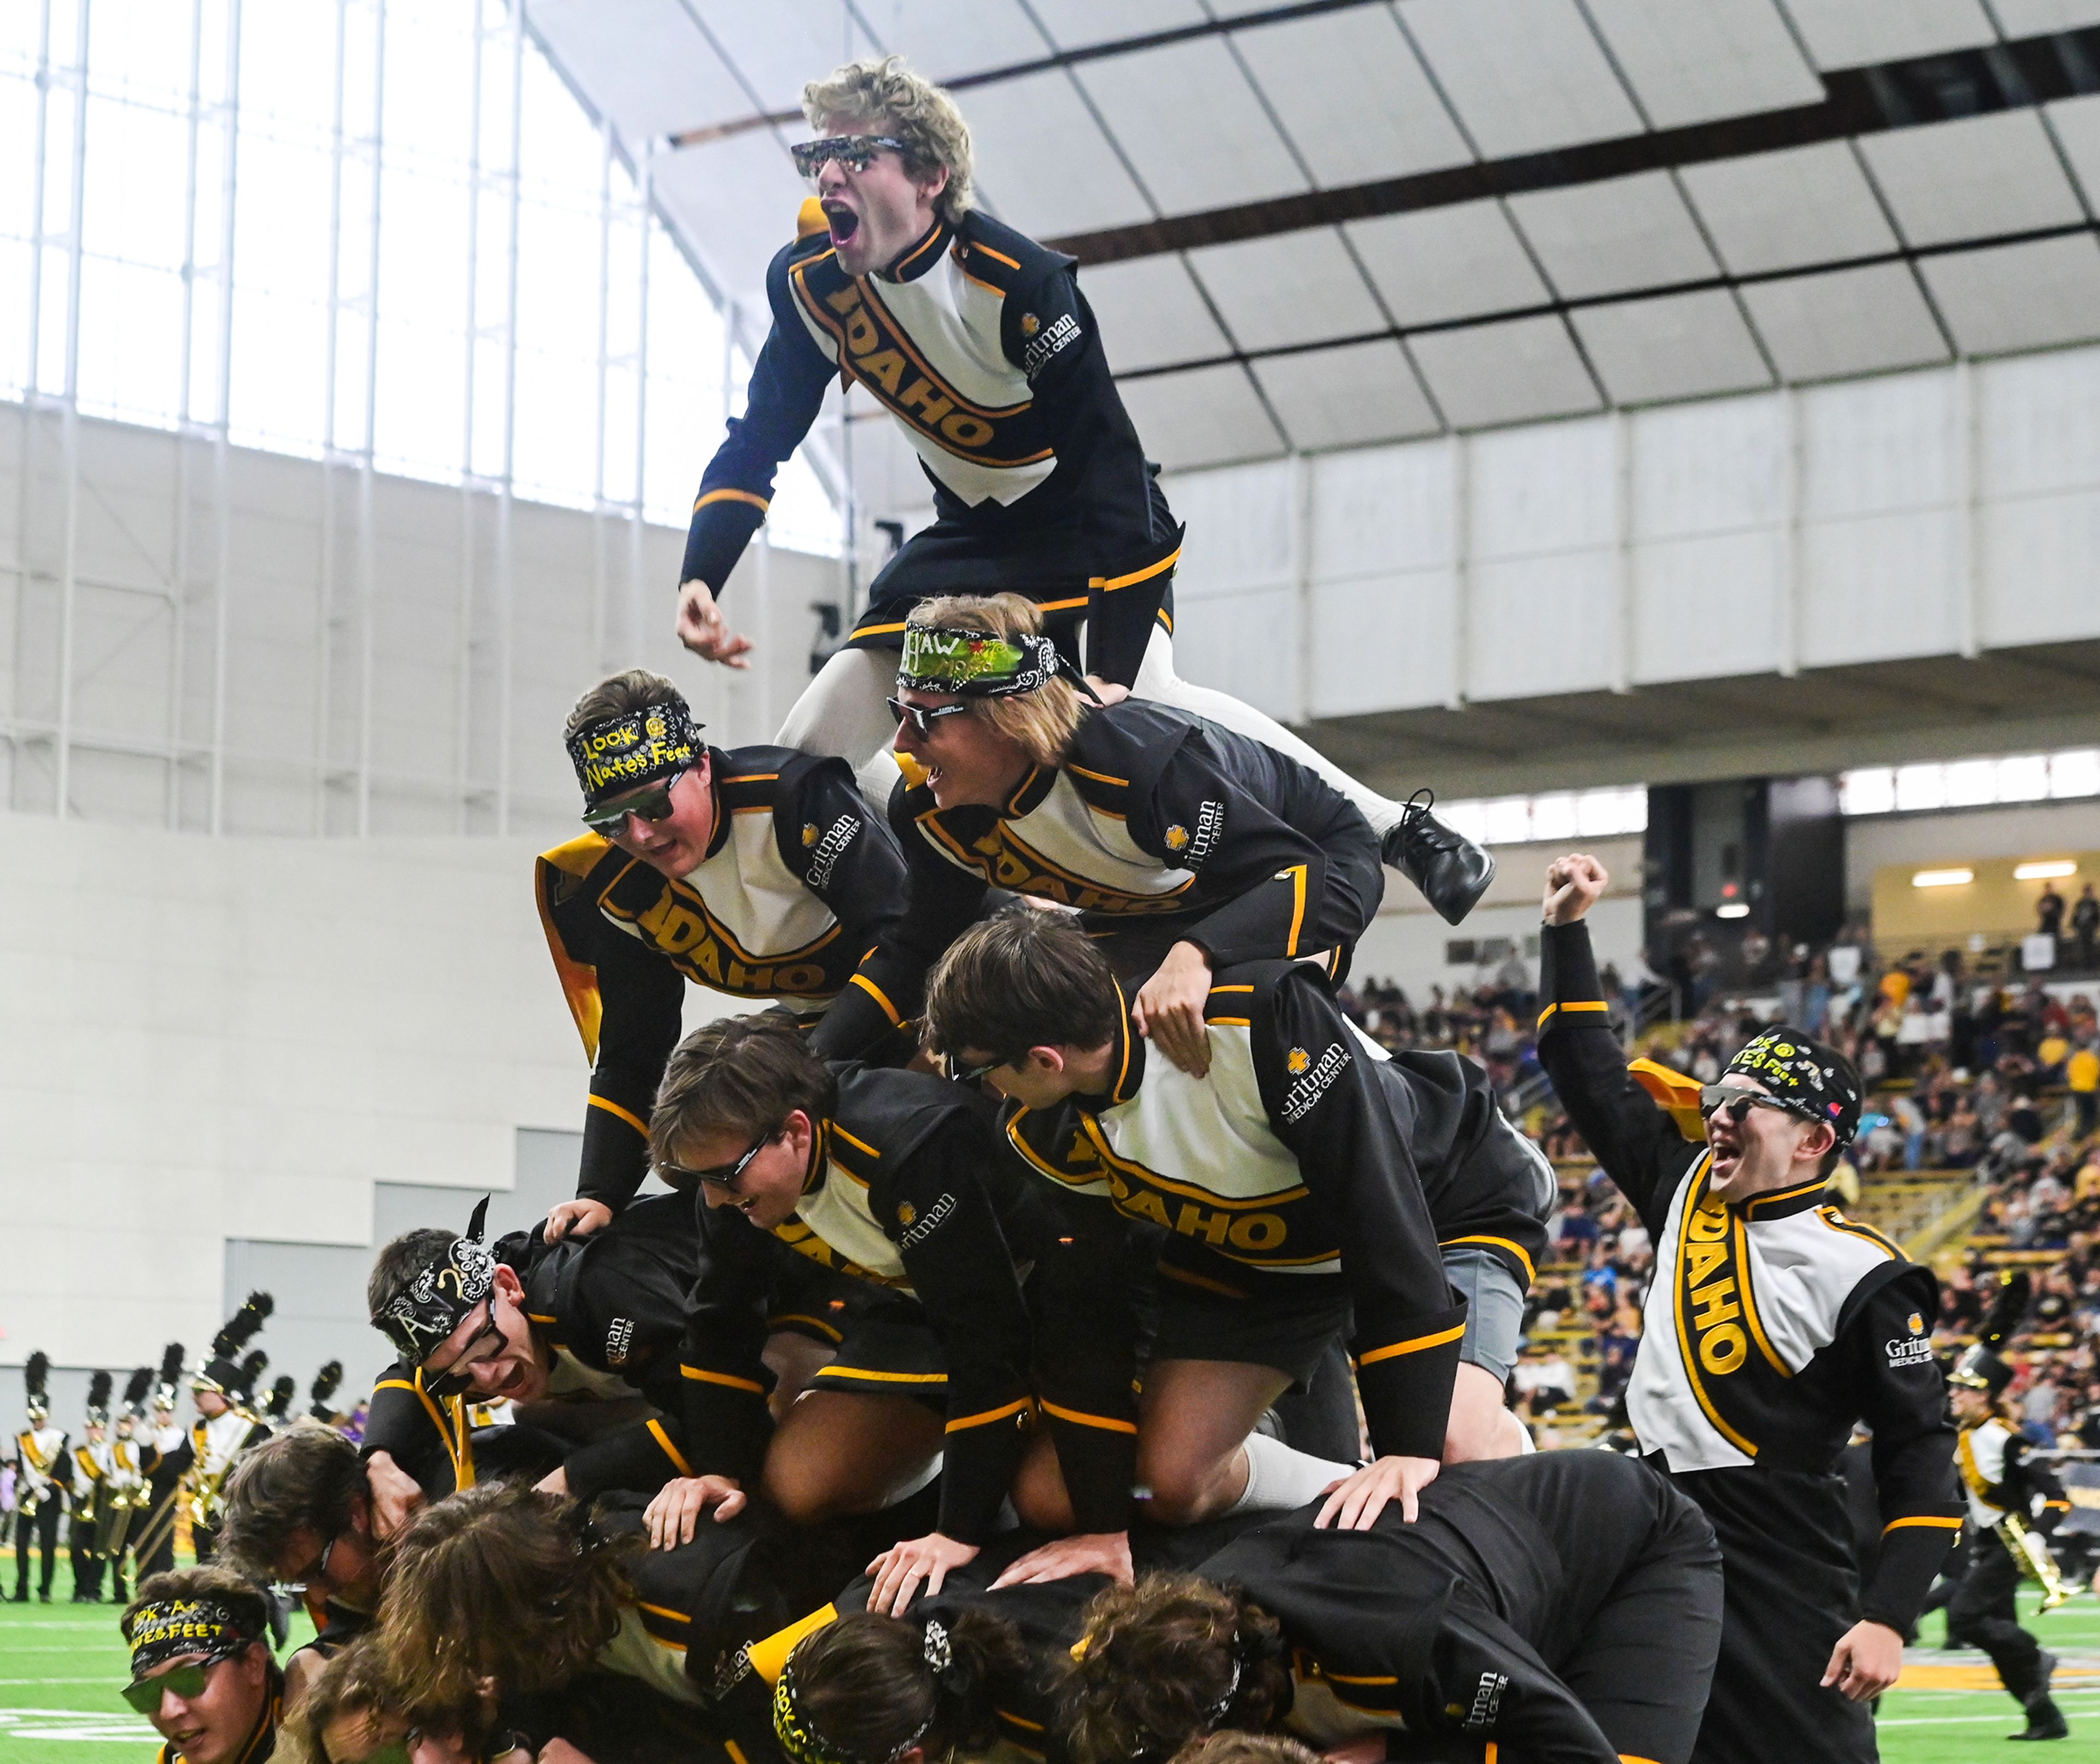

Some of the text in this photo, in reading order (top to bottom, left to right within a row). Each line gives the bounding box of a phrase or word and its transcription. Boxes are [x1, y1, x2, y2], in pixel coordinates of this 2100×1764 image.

[825, 283, 994, 447] IDAHO
[645, 717, 668, 738] @
[586, 754, 648, 792] Nates
[651, 741, 691, 766] Feet
[835, 820, 862, 852] CENTER
[1184, 800, 1216, 872] ritman
[1211, 802, 1224, 844] CENTER
[806, 814, 855, 886] Gritman
[637, 883, 826, 991] IDAHO
[1287, 1052, 1352, 1125] MEDICAL CENTER
[901, 1193, 956, 1249] ritman
[618, 1320, 635, 1359] CENTER
[168, 1623, 223, 1639] FEET
